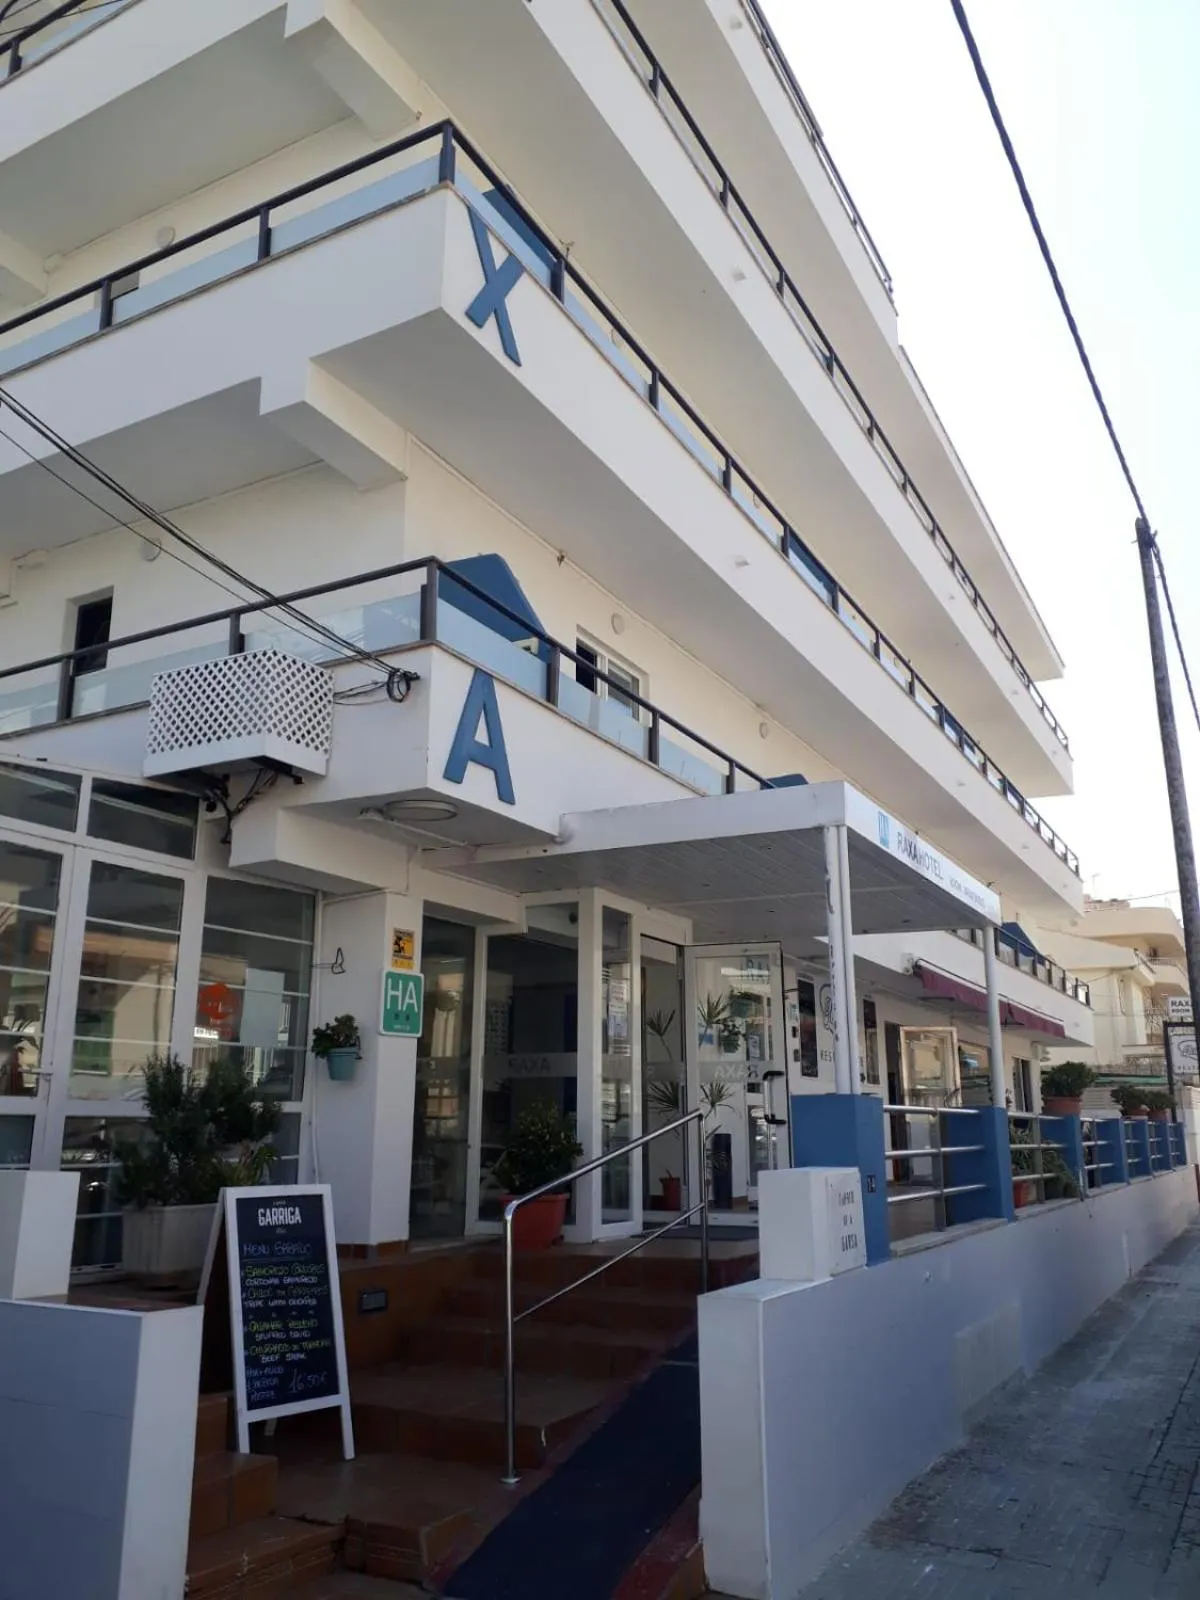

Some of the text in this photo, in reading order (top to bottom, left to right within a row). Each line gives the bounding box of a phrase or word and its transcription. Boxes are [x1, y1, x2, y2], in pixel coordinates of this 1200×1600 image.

[465, 206, 525, 367] X
[443, 667, 516, 806] A
[386, 977, 418, 1013] HA
[257, 1206, 303, 1227] GARRIGA
